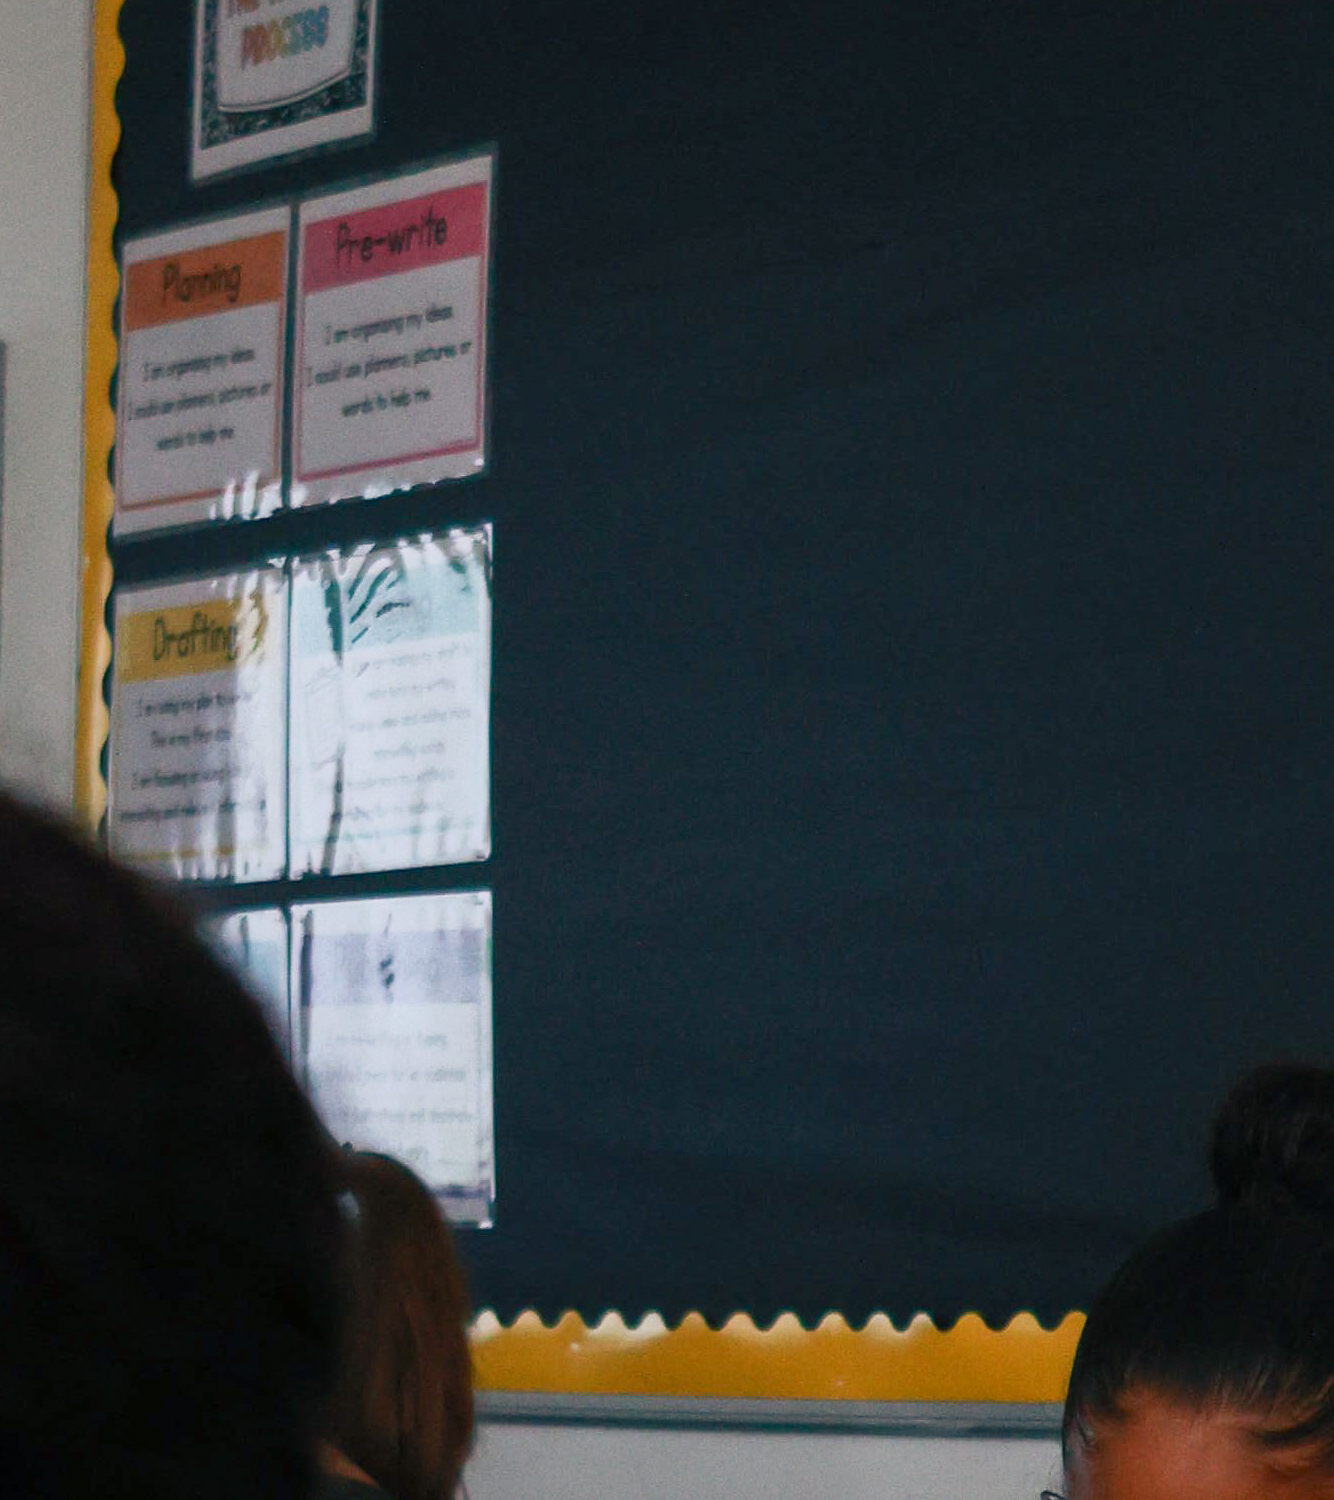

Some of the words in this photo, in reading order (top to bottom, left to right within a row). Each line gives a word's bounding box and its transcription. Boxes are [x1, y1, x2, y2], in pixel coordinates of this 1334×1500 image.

[335, 208, 449, 266] Pre-write
[162, 261, 243, 306] Planning
[153, 610, 238, 663] Drafting
